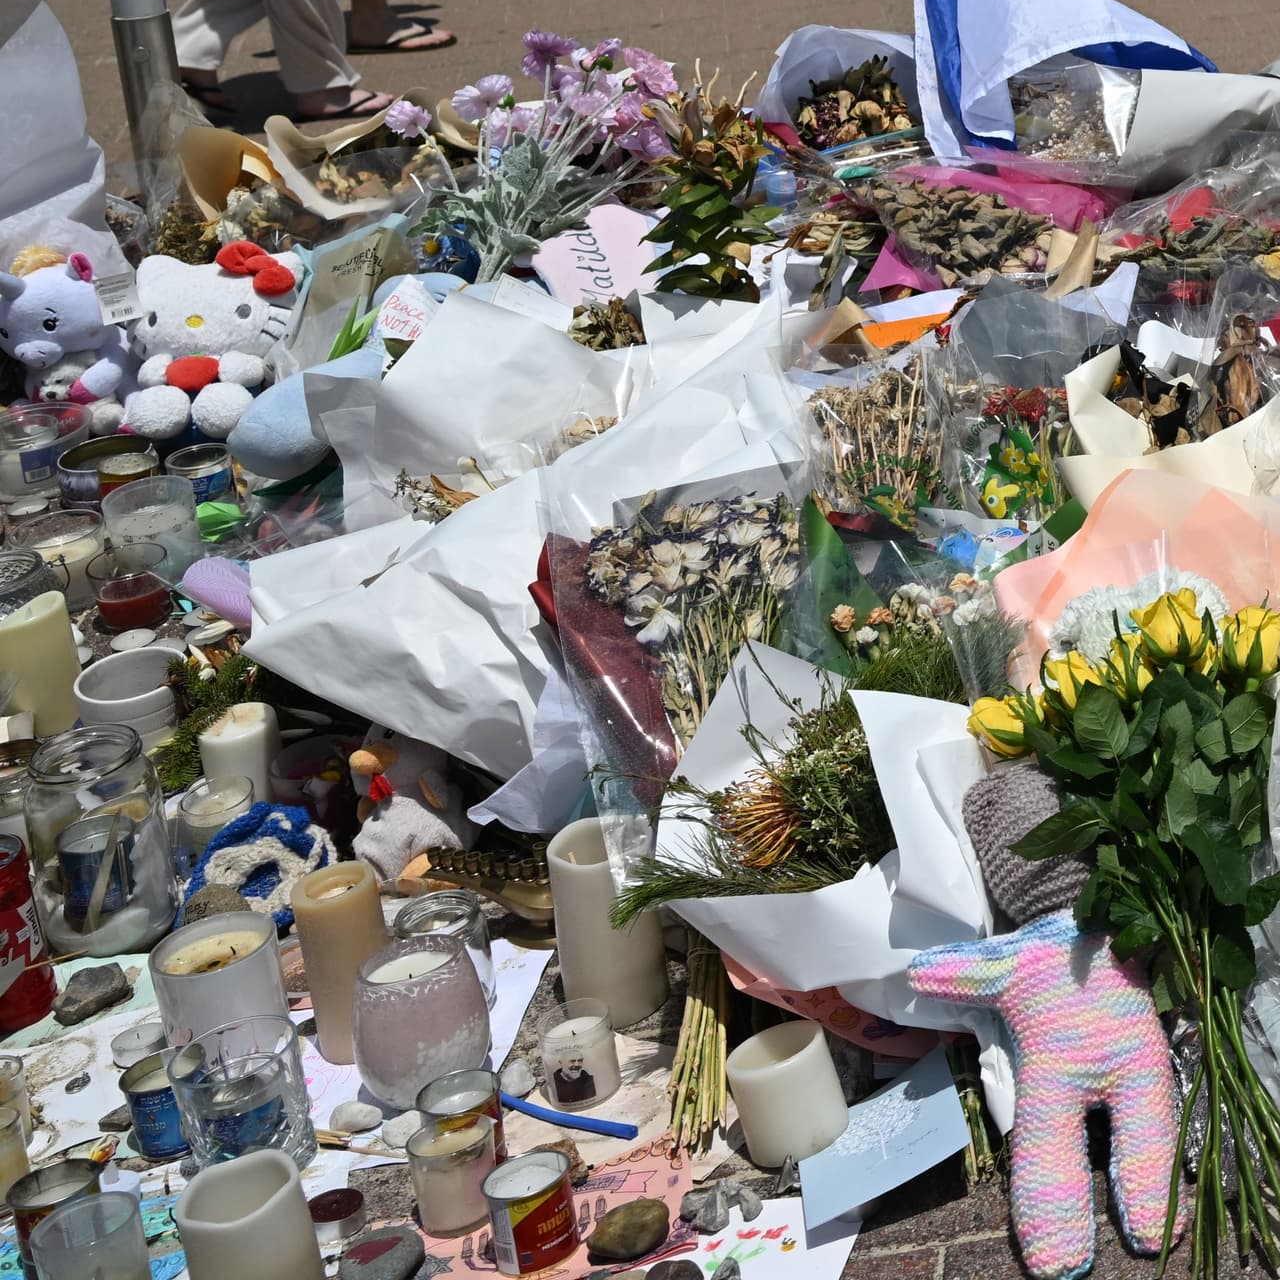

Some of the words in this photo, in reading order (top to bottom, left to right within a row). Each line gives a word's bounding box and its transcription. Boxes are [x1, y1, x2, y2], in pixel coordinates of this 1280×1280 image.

[565, 223, 616, 302] Matild
[384, 294, 425, 322] Peace
[381, 314, 409, 332] NOT
